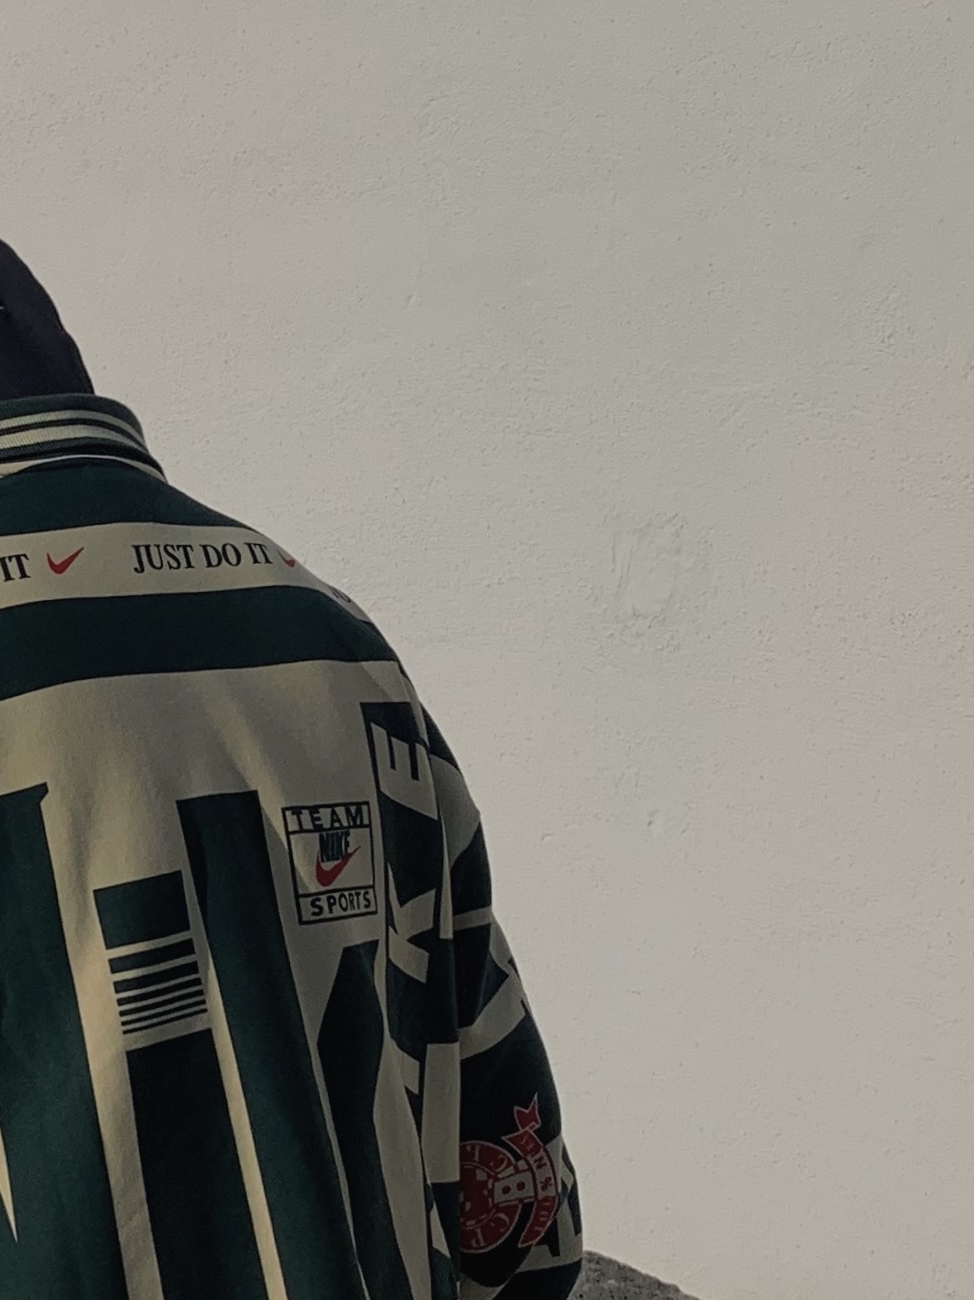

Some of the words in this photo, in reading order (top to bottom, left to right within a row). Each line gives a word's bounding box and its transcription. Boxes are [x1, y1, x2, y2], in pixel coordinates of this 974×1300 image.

[1, 552, 32, 583] IT
[132, 542, 197, 574] JUST
[201, 541, 243, 570] DO
[247, 540, 274, 566] IT
[290, 805, 365, 832] TEAM
[318, 829, 351, 863] NIKE
[310, 890, 372, 917] SPORTS
